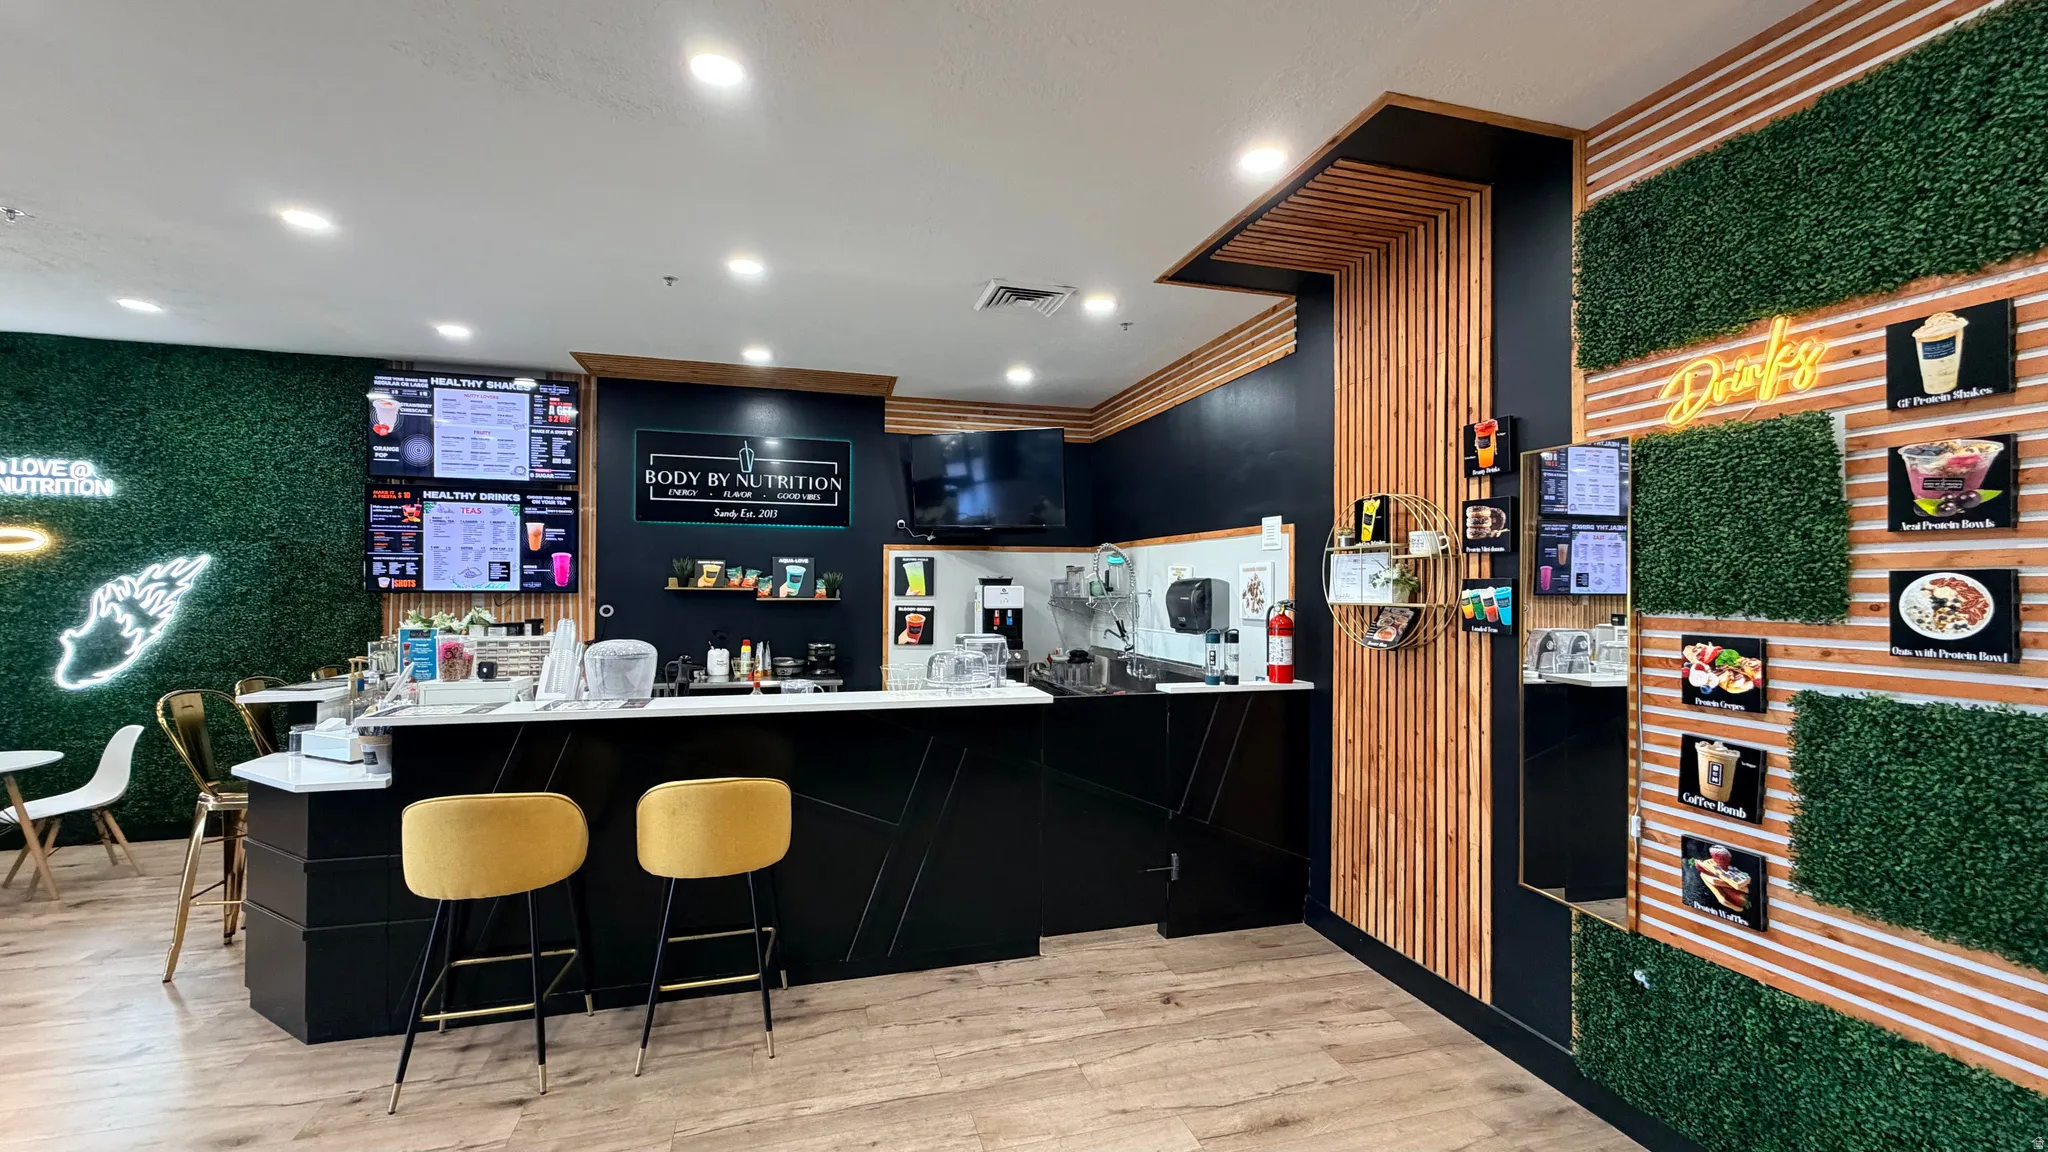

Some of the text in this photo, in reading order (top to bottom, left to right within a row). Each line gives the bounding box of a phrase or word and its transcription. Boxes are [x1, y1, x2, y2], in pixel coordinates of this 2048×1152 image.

[1660, 317, 1824, 425] Drinks
[431, 377, 483, 388] HEALTHY
[486, 381, 531, 391] SHAKES
[1896, 387, 1993, 408] GF Protein Shakes
[11, 459, 68, 476] LOVE
[70, 461, 92, 479] @
[0, 476, 113, 496] NUTRITION
[645, 469, 842, 491] BODY BY NUTRITION
[423, 490, 521, 502] HEALTHY DRINKS
[668, 488, 698, 497] ENERGY
[723, 490, 752, 499] FLAVOR
[777, 492, 821, 501] GOOD VIBES
[713, 507, 778, 520] Sandy Est. 2013
[1922, 520, 1960, 530] Protein
[1961, 519, 1995, 529] Bowls
[394, 579, 416, 588] SHOTS
[1891, 646, 2008, 663] Oats with Protein Bowl
[1694, 697, 1745, 711] Protein Crepes
[1682, 792, 1747, 819] Coffee Bomb
[1693, 901, 1749, 926] Protein Waffles
